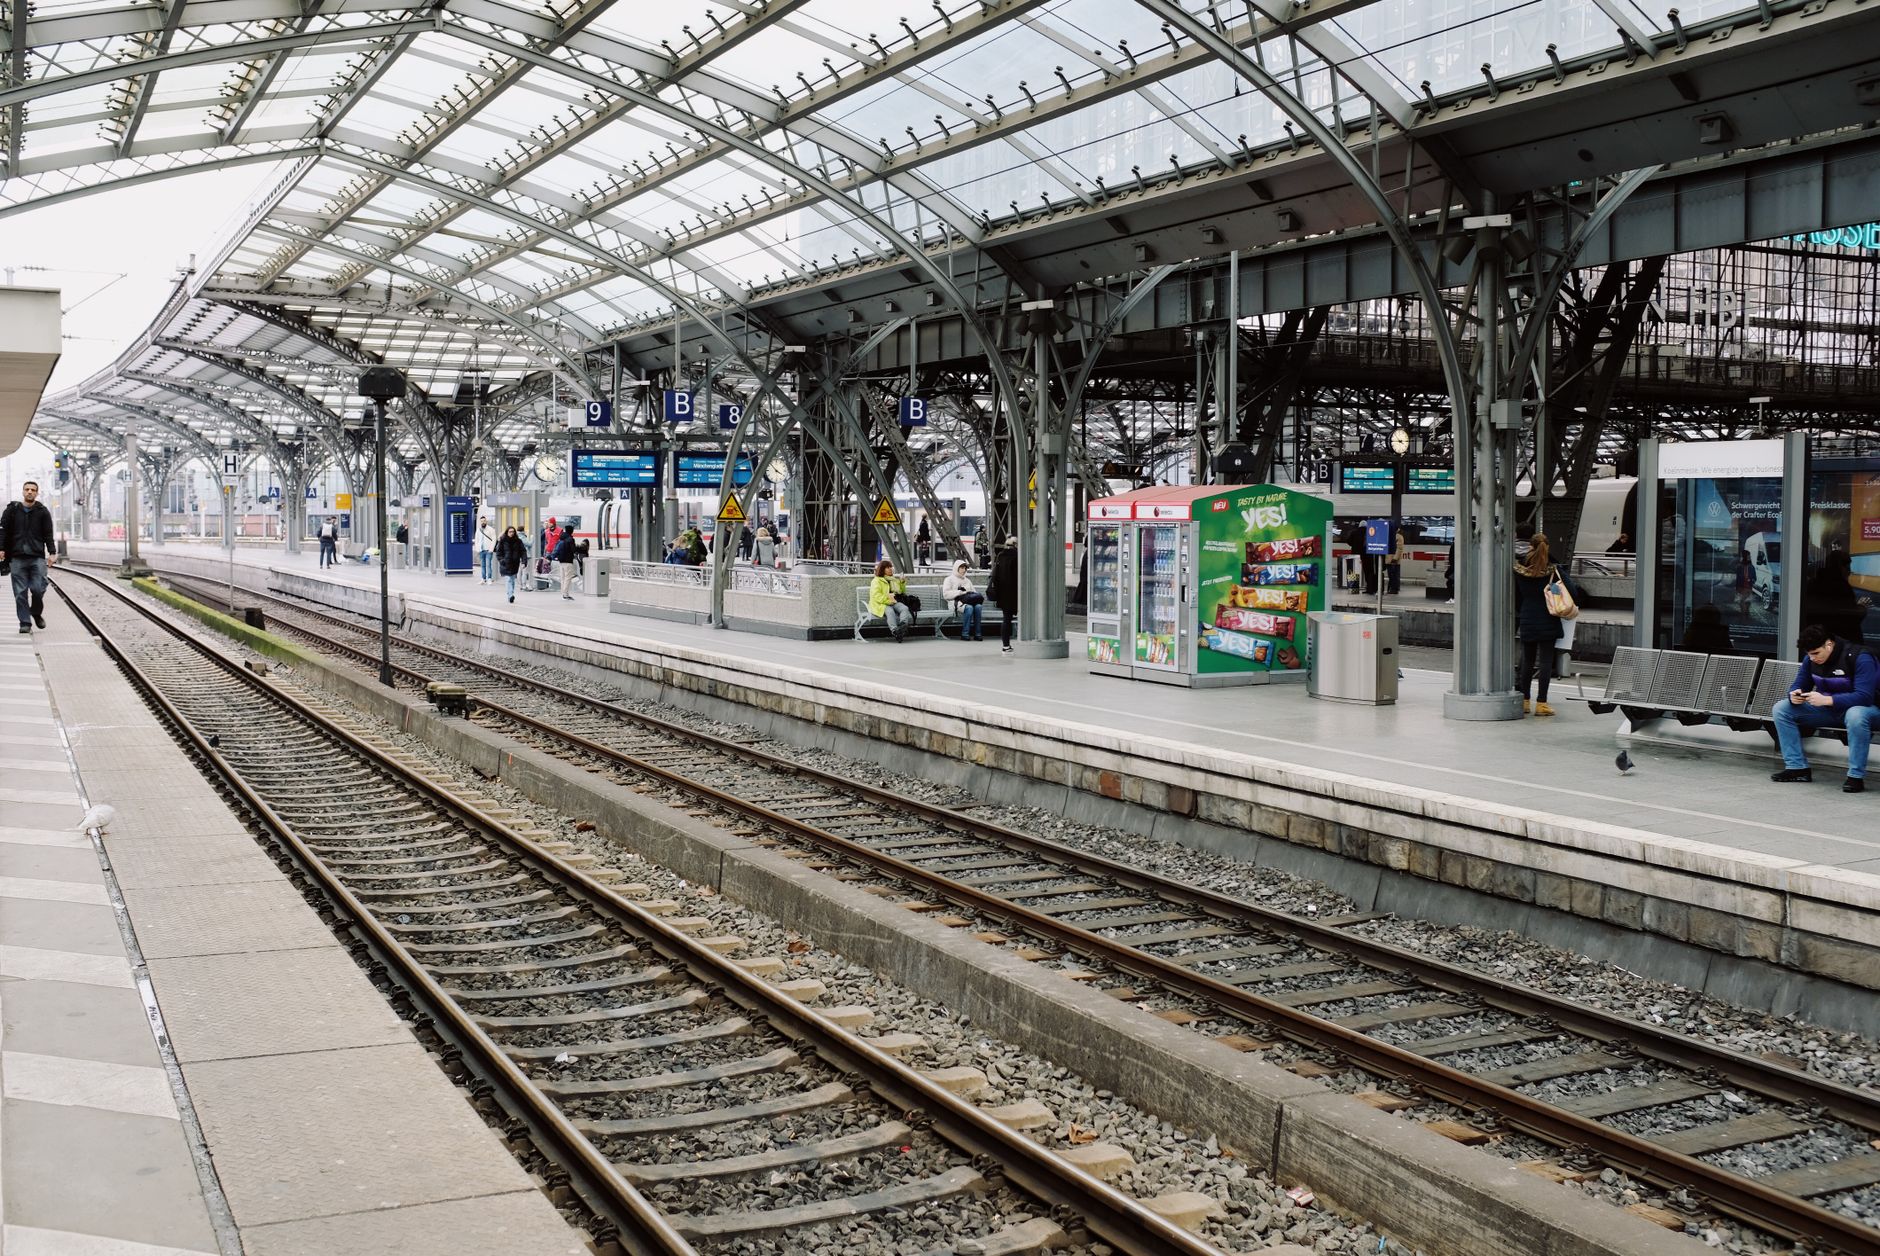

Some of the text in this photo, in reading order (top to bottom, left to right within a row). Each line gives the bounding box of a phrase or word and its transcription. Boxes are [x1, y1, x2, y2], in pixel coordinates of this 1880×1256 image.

[1689, 285, 1758, 330] HBF
[589, 402, 602, 421] 9
[675, 392, 690, 415] B
[909, 398, 924, 420] B
[728, 406, 740, 424] 8
[1359, 433, 1368, 449] 7
[224, 455, 237, 474] H
[1319, 464, 1329, 479] B
[270, 488, 277, 497] A
[308, 488, 316, 497] A
[621, 490, 628, 498] A
[1213, 501, 1227, 511] NEU
[1731, 501, 1851, 511] Schwergewicht Preisklasse:
[1731, 511, 1742, 519] der
[1743, 511, 1767, 519] Crafter
[1240, 503, 1288, 533] YES!
[1270, 538, 1299, 556] YES!
[1266, 563, 1295, 581] YES!
[1256, 588, 1284, 604] YES!
[1236, 611, 1274, 632] YES!
[1217, 629, 1253, 655] YES!
